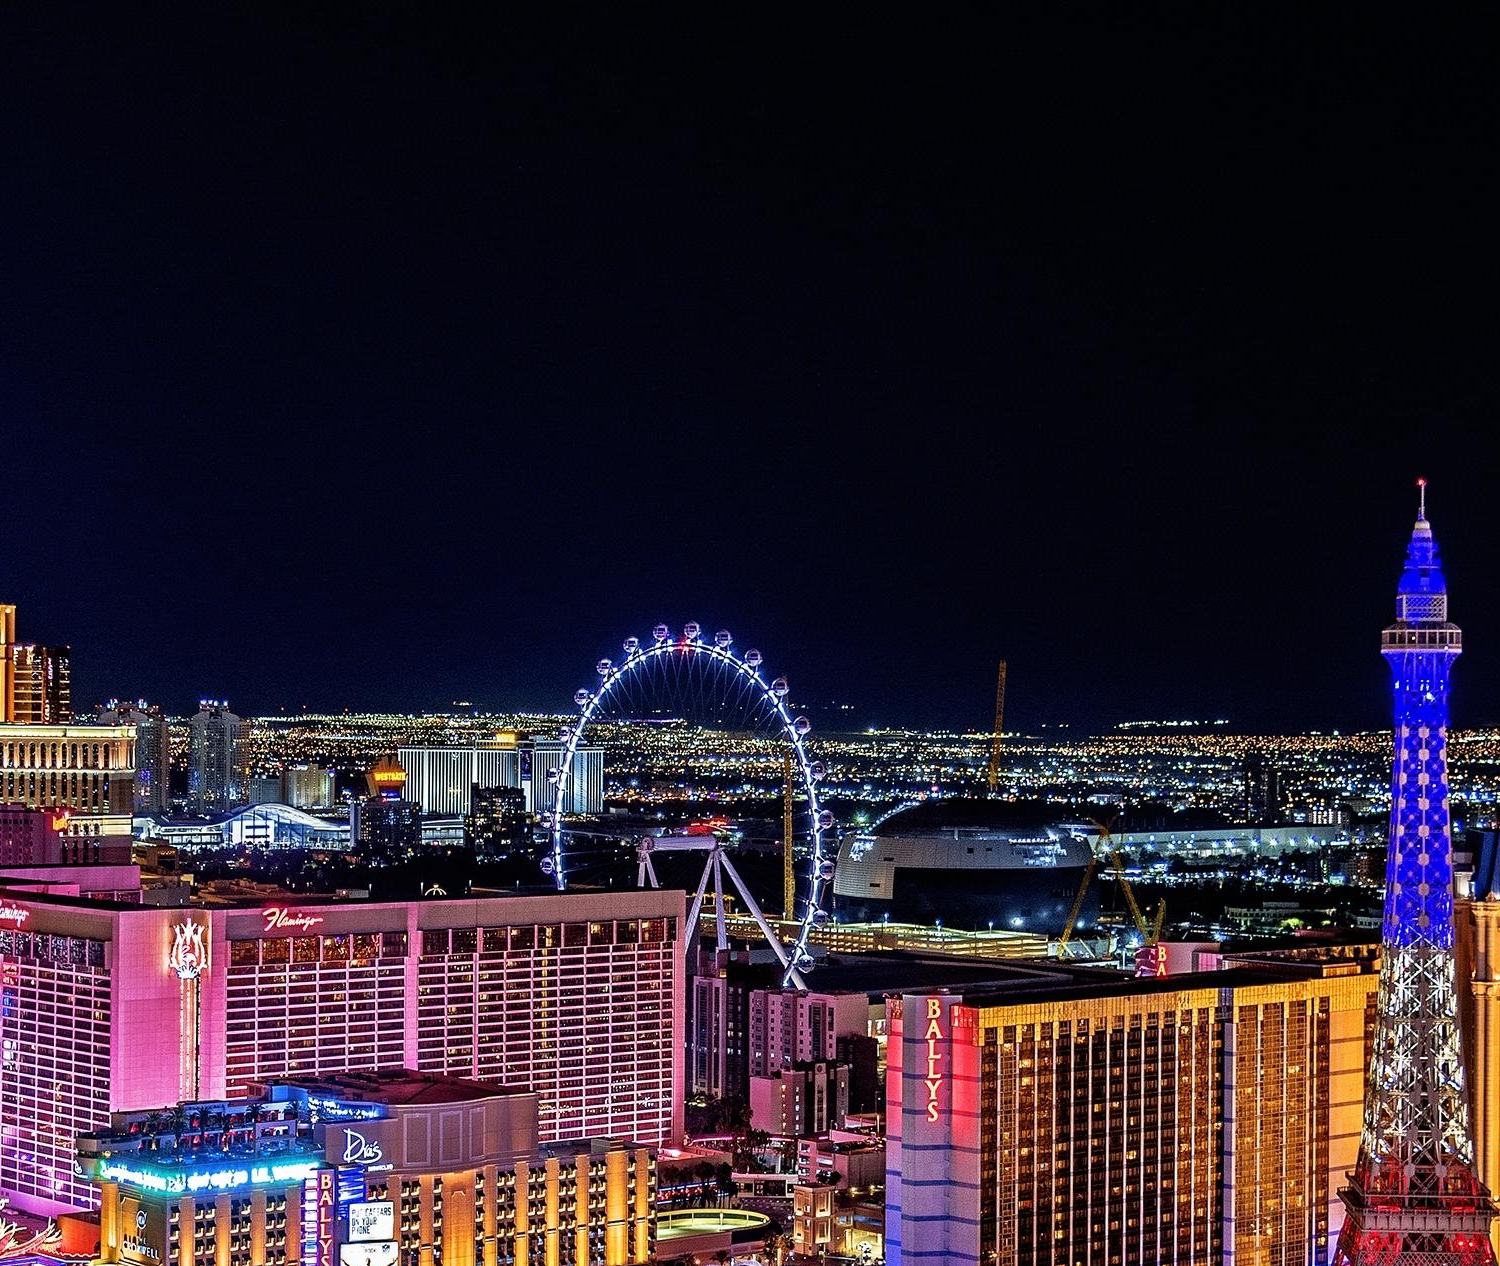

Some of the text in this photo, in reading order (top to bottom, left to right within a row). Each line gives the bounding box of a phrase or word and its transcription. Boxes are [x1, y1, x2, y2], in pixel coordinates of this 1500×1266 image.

[262, 907, 324, 932] Flamingo
[925, 999, 943, 1122] BALLYS
[362, 1217, 377, 1226] YOUR
